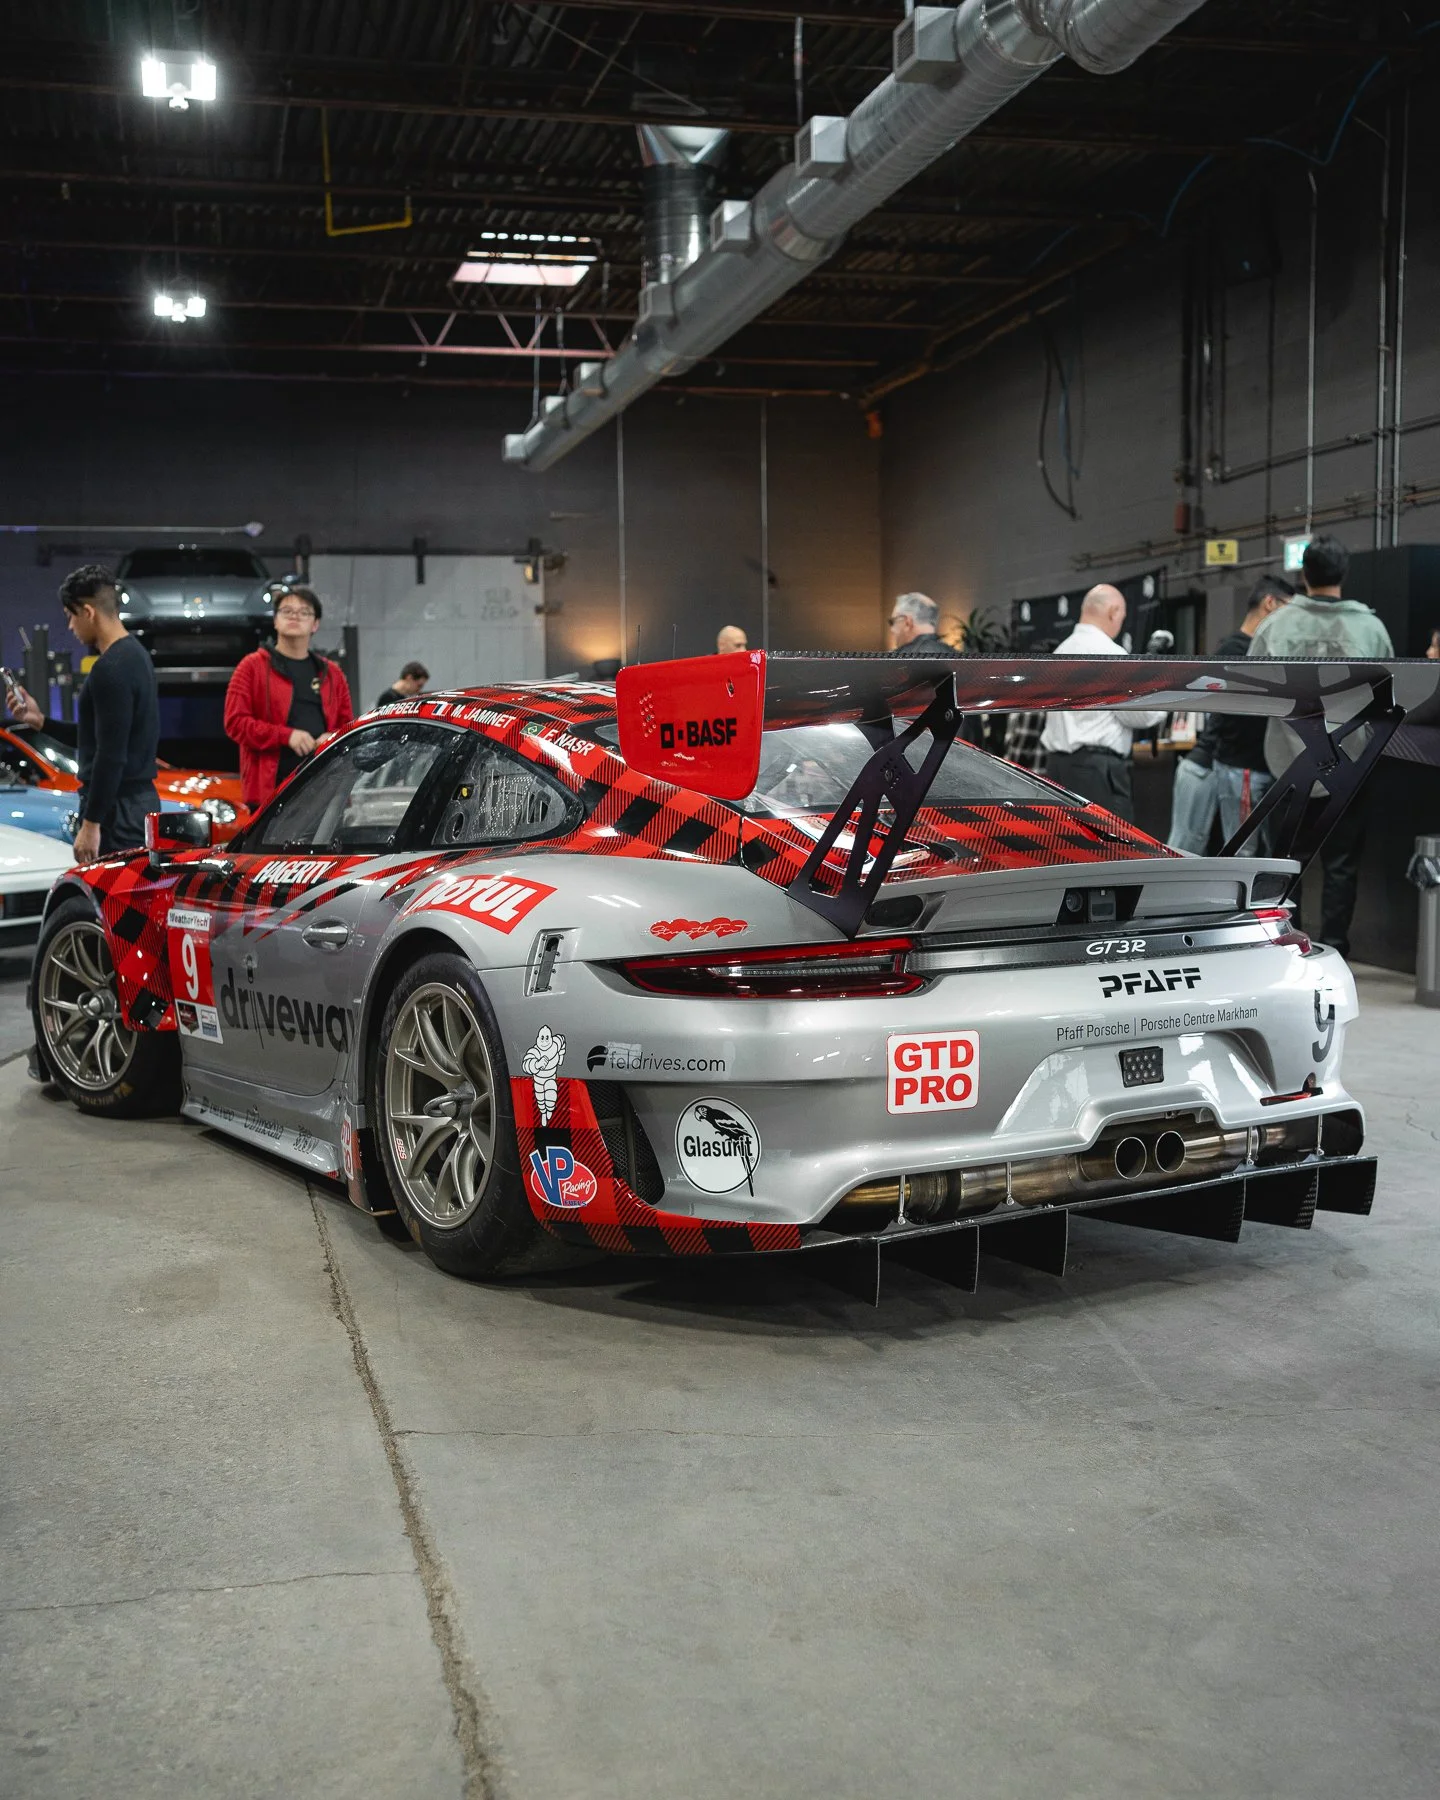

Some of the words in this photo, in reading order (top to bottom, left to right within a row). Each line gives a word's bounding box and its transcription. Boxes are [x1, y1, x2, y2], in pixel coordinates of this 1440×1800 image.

[450, 704, 466, 719] M.
[463, 707, 517, 729] JAMINET
[554, 733, 596, 757] NASR
[686, 718, 737, 747] BASF
[252, 860, 338, 884] HAGERTY
[1085, 938, 1147, 956] GT3R
[181, 933, 199, 1000] 9
[1097, 967, 1202, 999] PFAFF
[1056, 1026, 1084, 1041] Pfaff
[1086, 1021, 1130, 1038] Porsche
[1140, 1015, 1181, 1032] Porsche
[1183, 1012, 1215, 1027] Centre
[1217, 1006, 1258, 1022] Markham
[894, 1039, 974, 1073] GTD
[894, 1073, 972, 1106] PRO
[683, 1135, 753, 1158] Glasurit
[528, 1145, 575, 1208] VP
[562, 1179, 597, 1200] Racing
